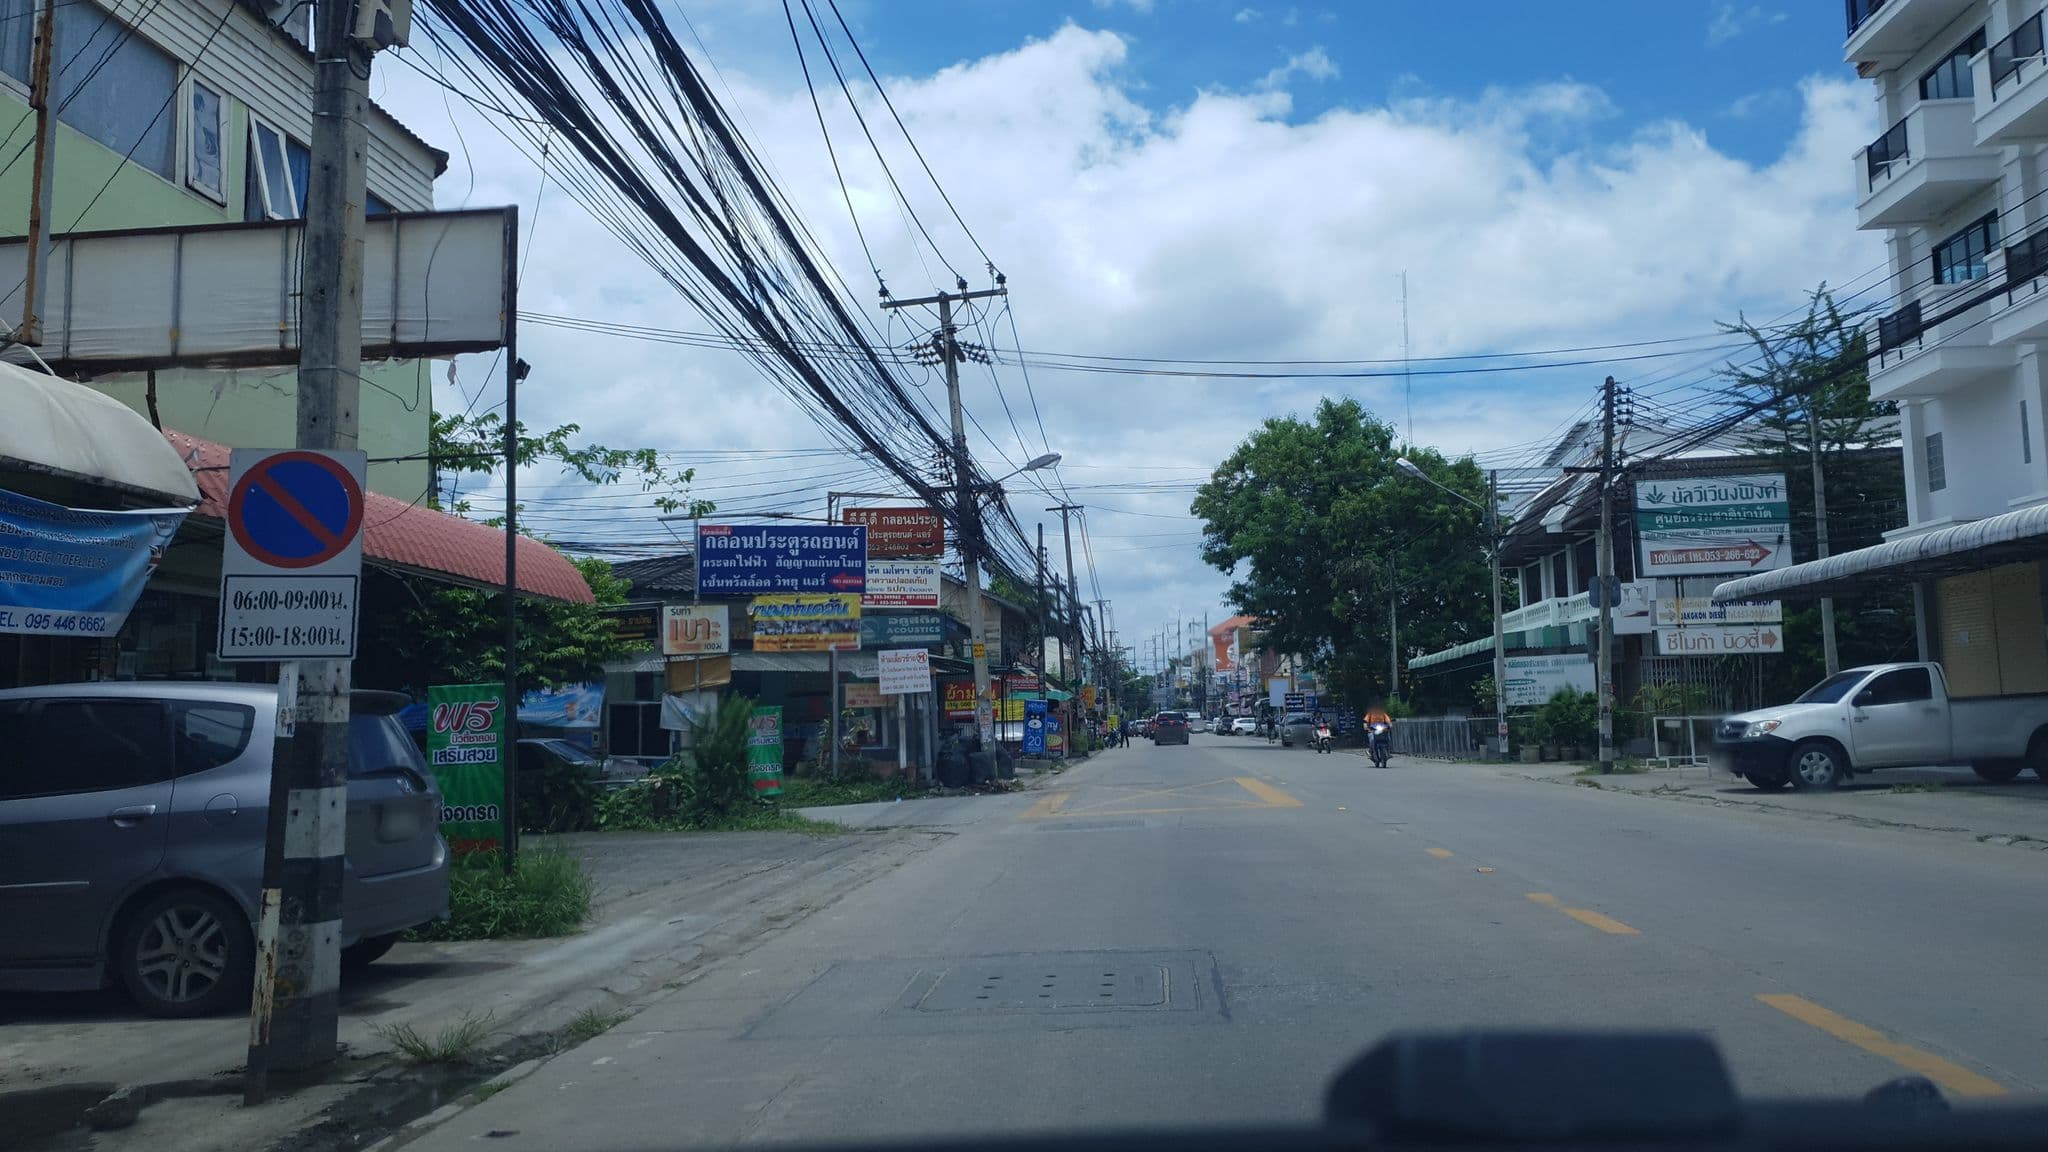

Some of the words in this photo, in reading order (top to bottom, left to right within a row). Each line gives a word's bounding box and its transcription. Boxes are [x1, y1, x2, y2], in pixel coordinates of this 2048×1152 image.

[1672, 479, 1778, 503] บัลวีเวียงพิงค์
[705, 528, 859, 556] กลอนประตูรถยนต์
[775, 574, 798, 590] วิทยุ
[803, 572, 826, 586] แอร์
[233, 590, 348, 611] 06:00-09:00น.
[0, 611, 19, 627] EL.
[25, 614, 51, 630] 095
[54, 616, 76, 631] 446
[79, 616, 106, 632] 6662
[669, 617, 721, 642] เบาะ
[229, 626, 346, 648] 15:00-18:00น.
[433, 695, 500, 733] พร
[1028, 735, 1042, 747] 20
[433, 747, 497, 764] เสริมสวย
